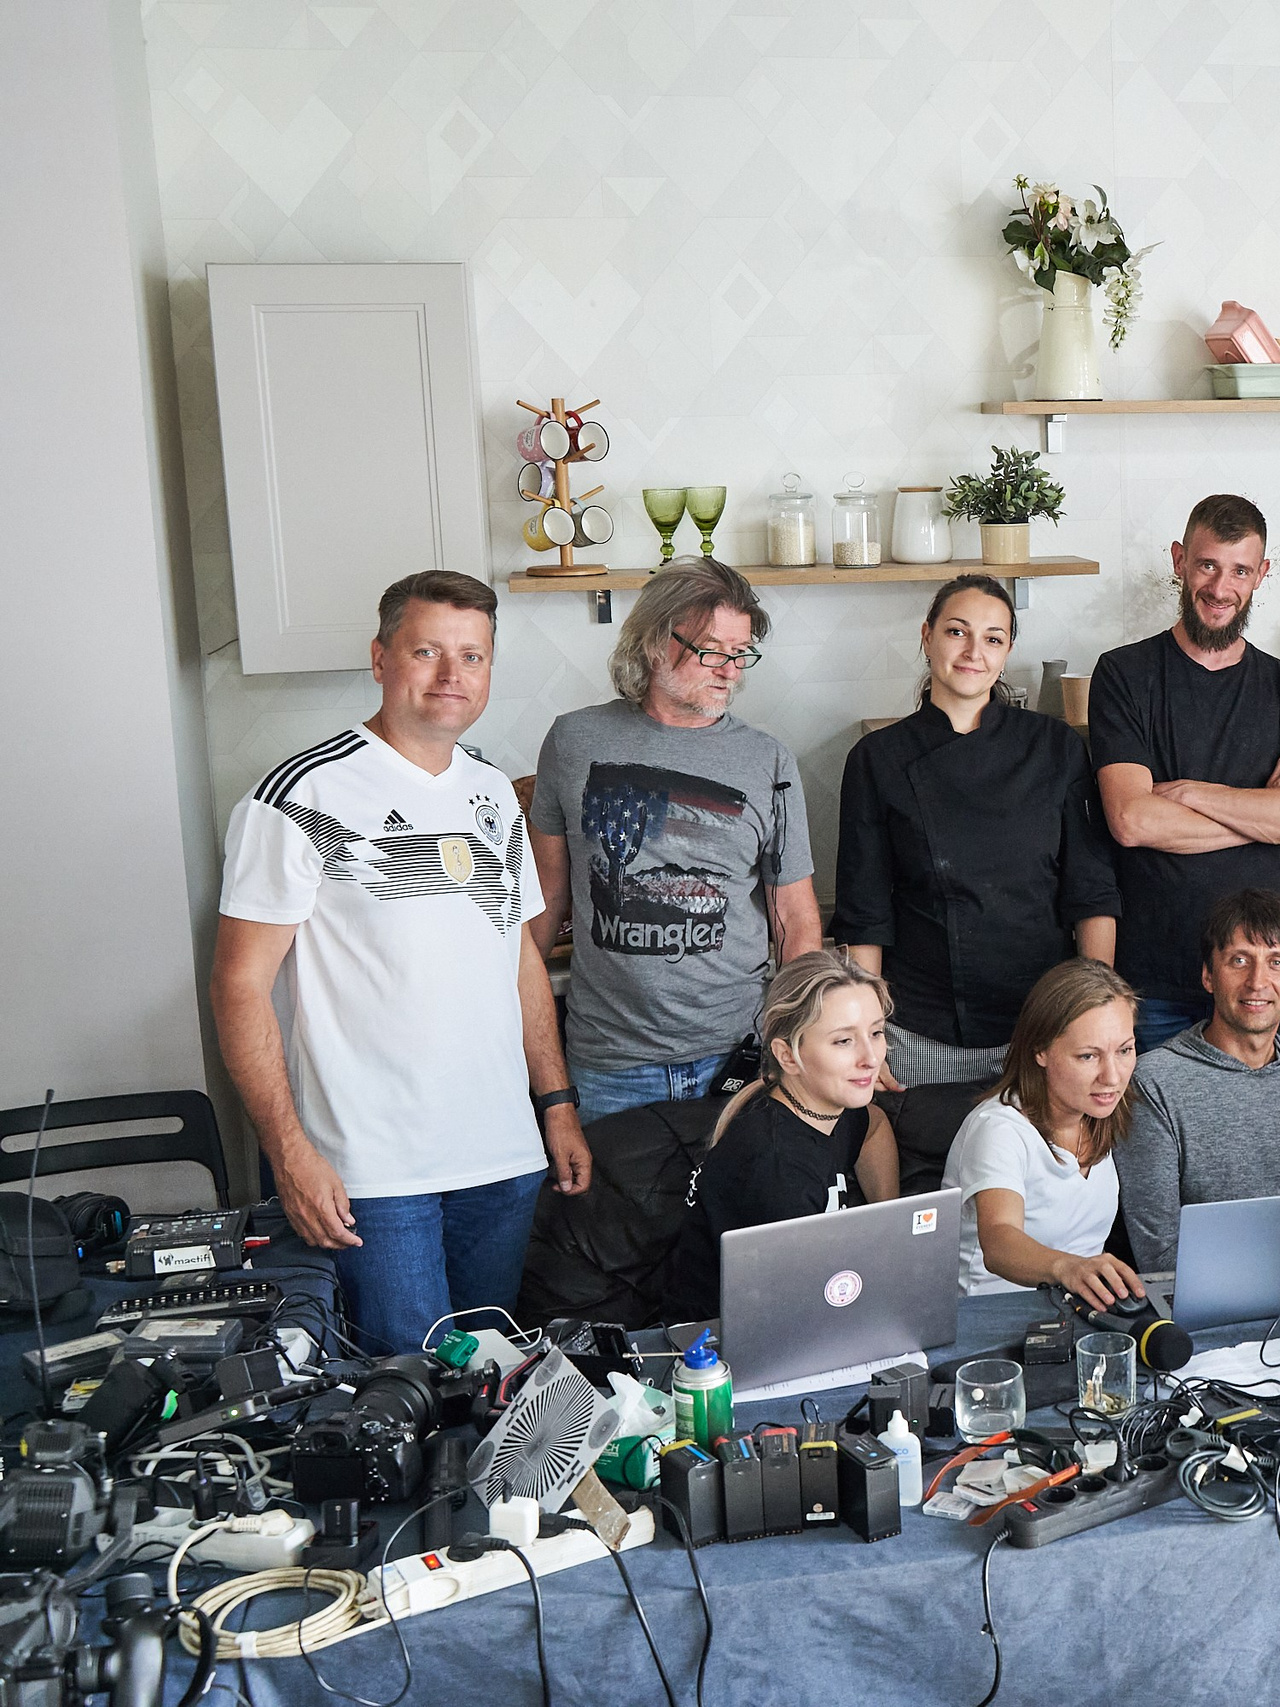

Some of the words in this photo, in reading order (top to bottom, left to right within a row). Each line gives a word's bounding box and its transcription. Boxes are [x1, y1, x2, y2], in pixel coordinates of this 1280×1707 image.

[383, 822, 414, 832] adidas
[597, 908, 724, 964] Wrangler
[724, 1079, 742, 1092] 23
